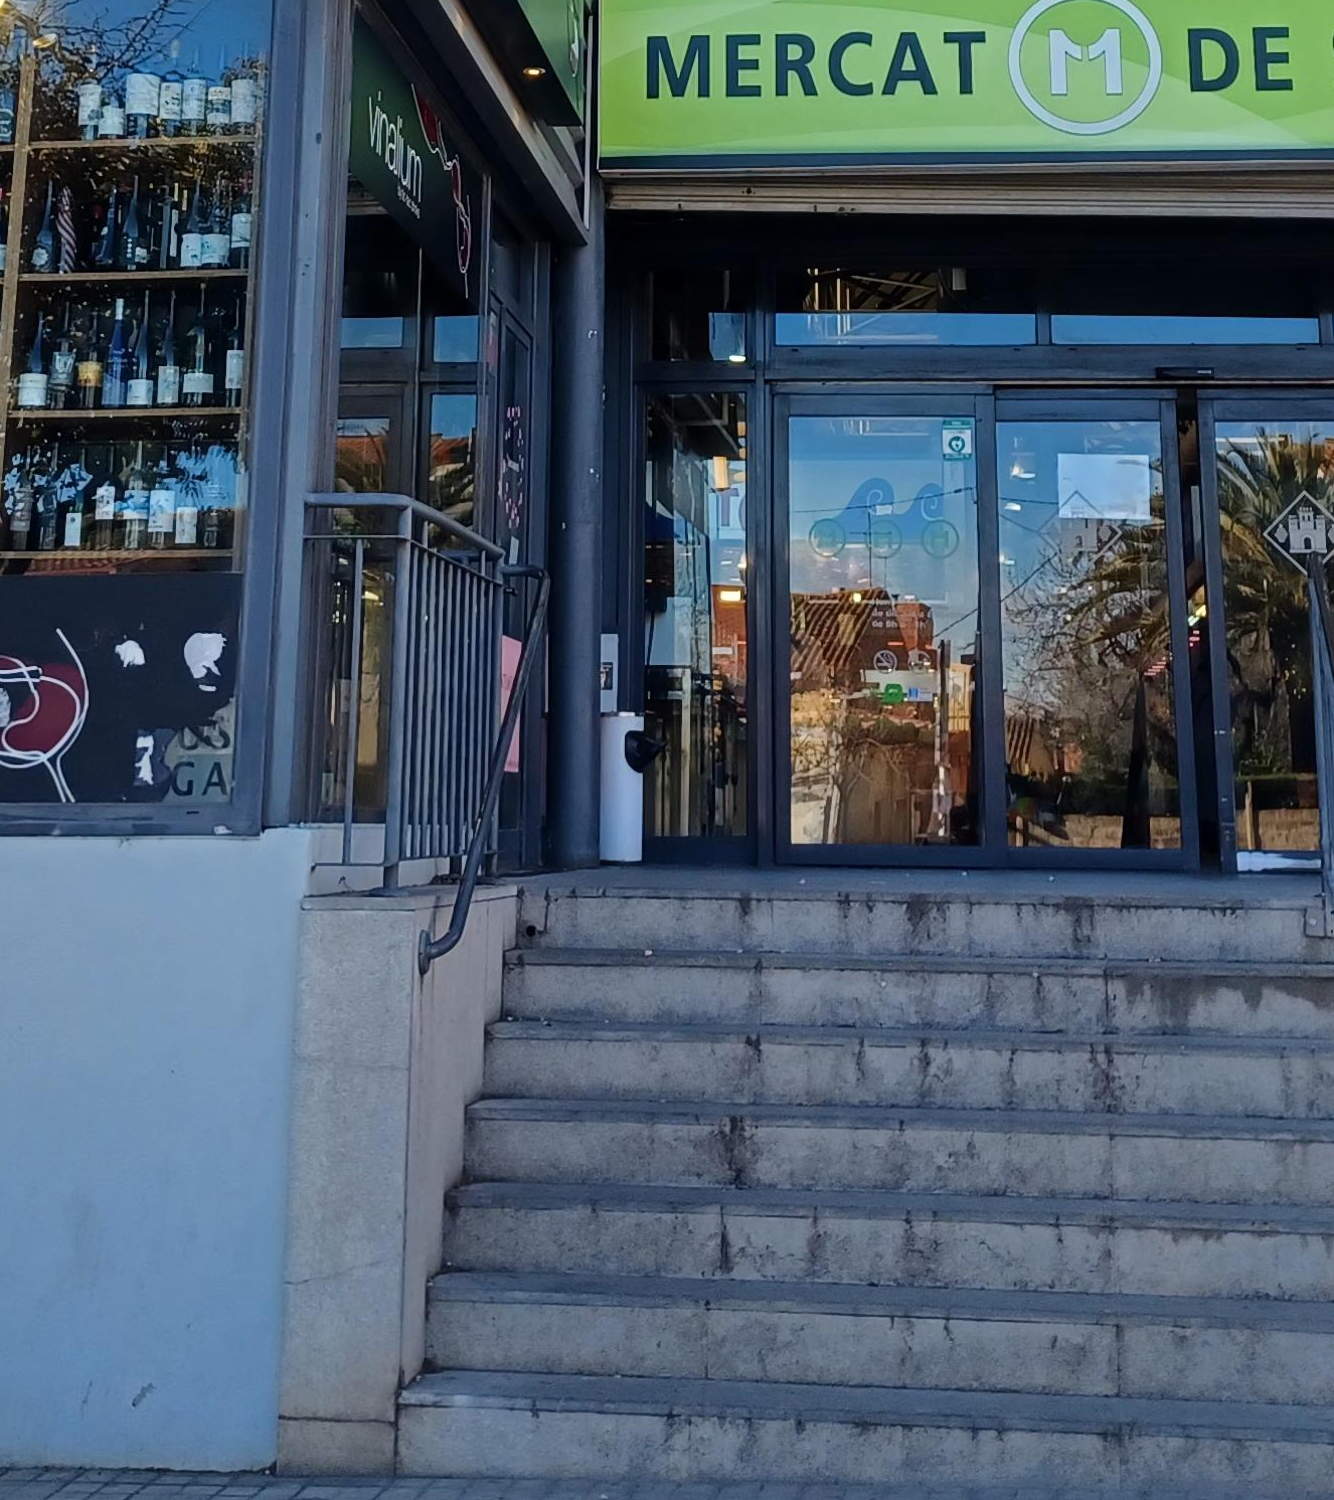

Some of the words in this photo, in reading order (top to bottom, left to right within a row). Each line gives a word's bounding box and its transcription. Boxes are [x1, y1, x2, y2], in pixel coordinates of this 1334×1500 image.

[646, 32, 986, 100] MERCAT
[1187, 27, 1293, 92] DE
[369, 90, 422, 203] vinalium
